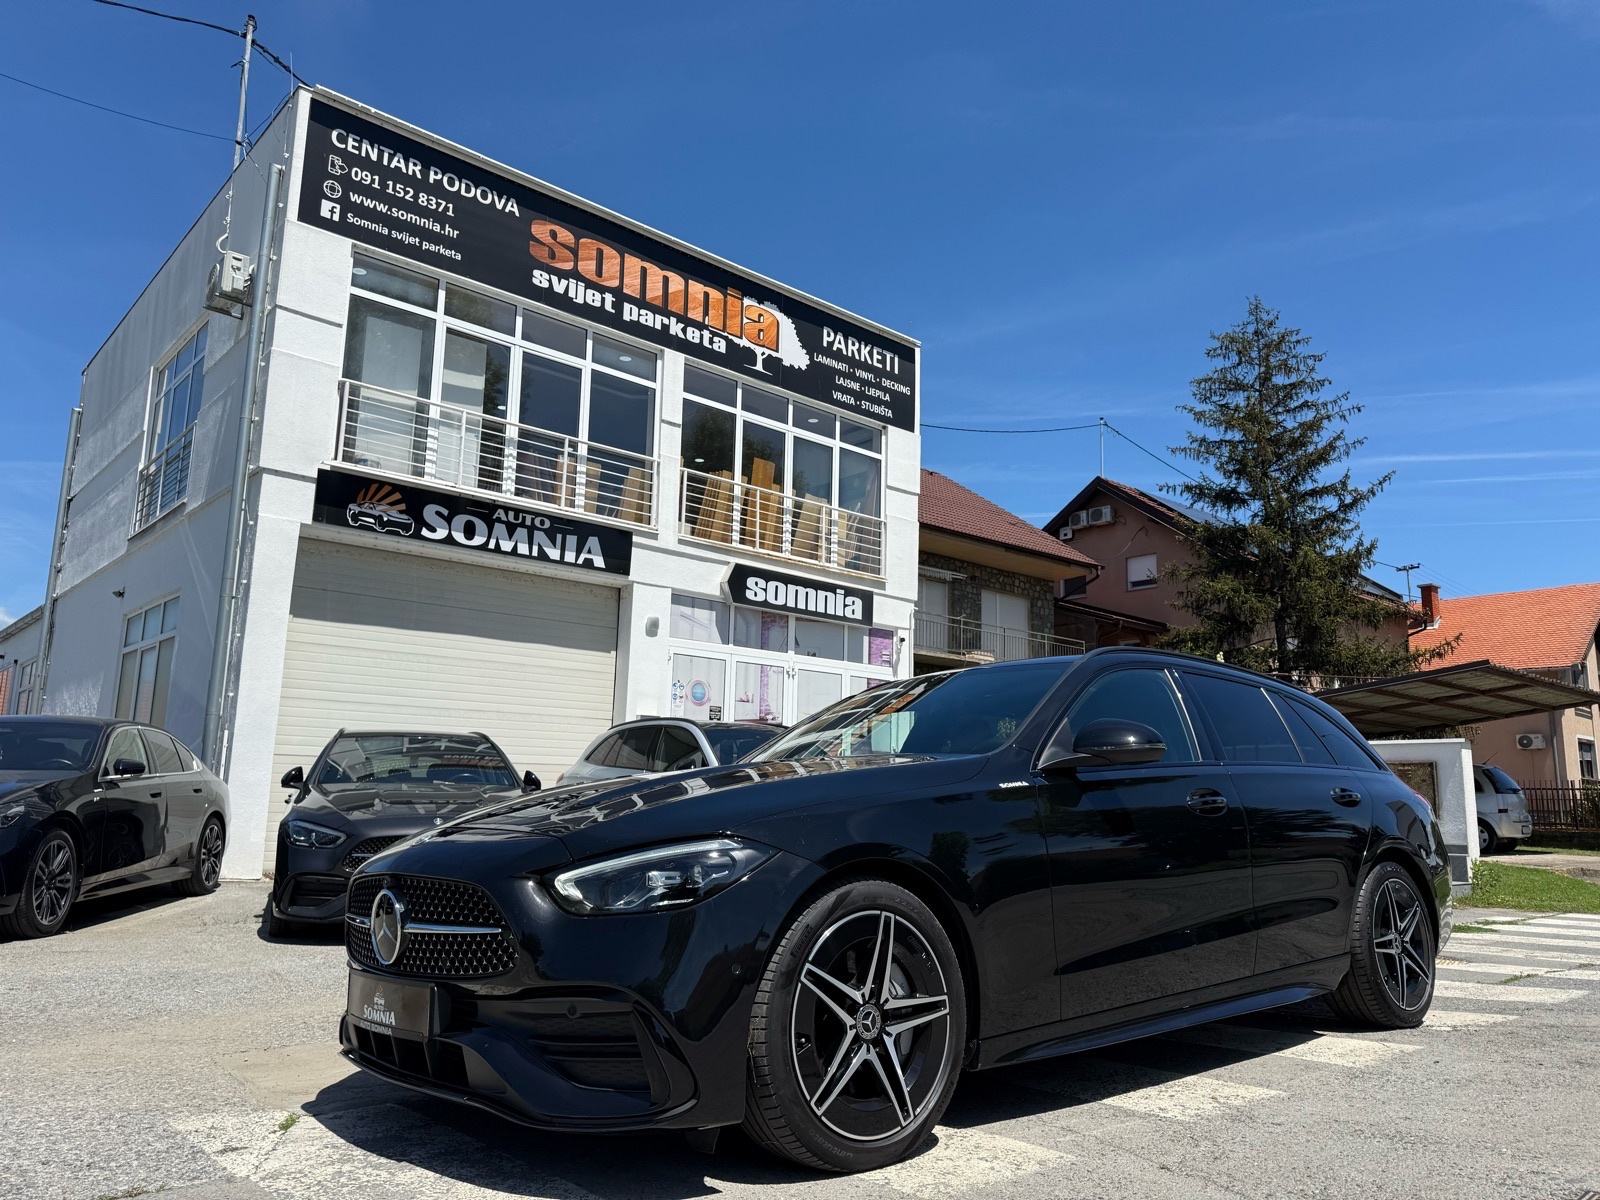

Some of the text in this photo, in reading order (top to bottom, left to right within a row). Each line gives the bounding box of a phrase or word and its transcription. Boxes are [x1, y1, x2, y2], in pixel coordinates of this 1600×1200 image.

[331, 128, 520, 218] CENTAR PODOVA
[351, 167, 455, 217] 091 152 8371
[346, 212, 462, 261] Somnia svijet parketa
[349, 191, 460, 240] www.somnia.hr
[528, 218, 780, 352] somnia
[532, 269, 727, 354] svijet parketa
[813, 352, 911, 396] LAMINATI VINYL DECKING
[822, 326, 899, 375] PARKETI
[832, 390, 893, 418] VRATA STUBIŠTA
[835, 375, 890, 402] LAJSNE LJEPILA
[420, 503, 606, 569] SOMNIA
[492, 508, 551, 529] AUTO
[745, 576, 863, 621] somnia
[363, 1004, 396, 1026] SOMNIA
